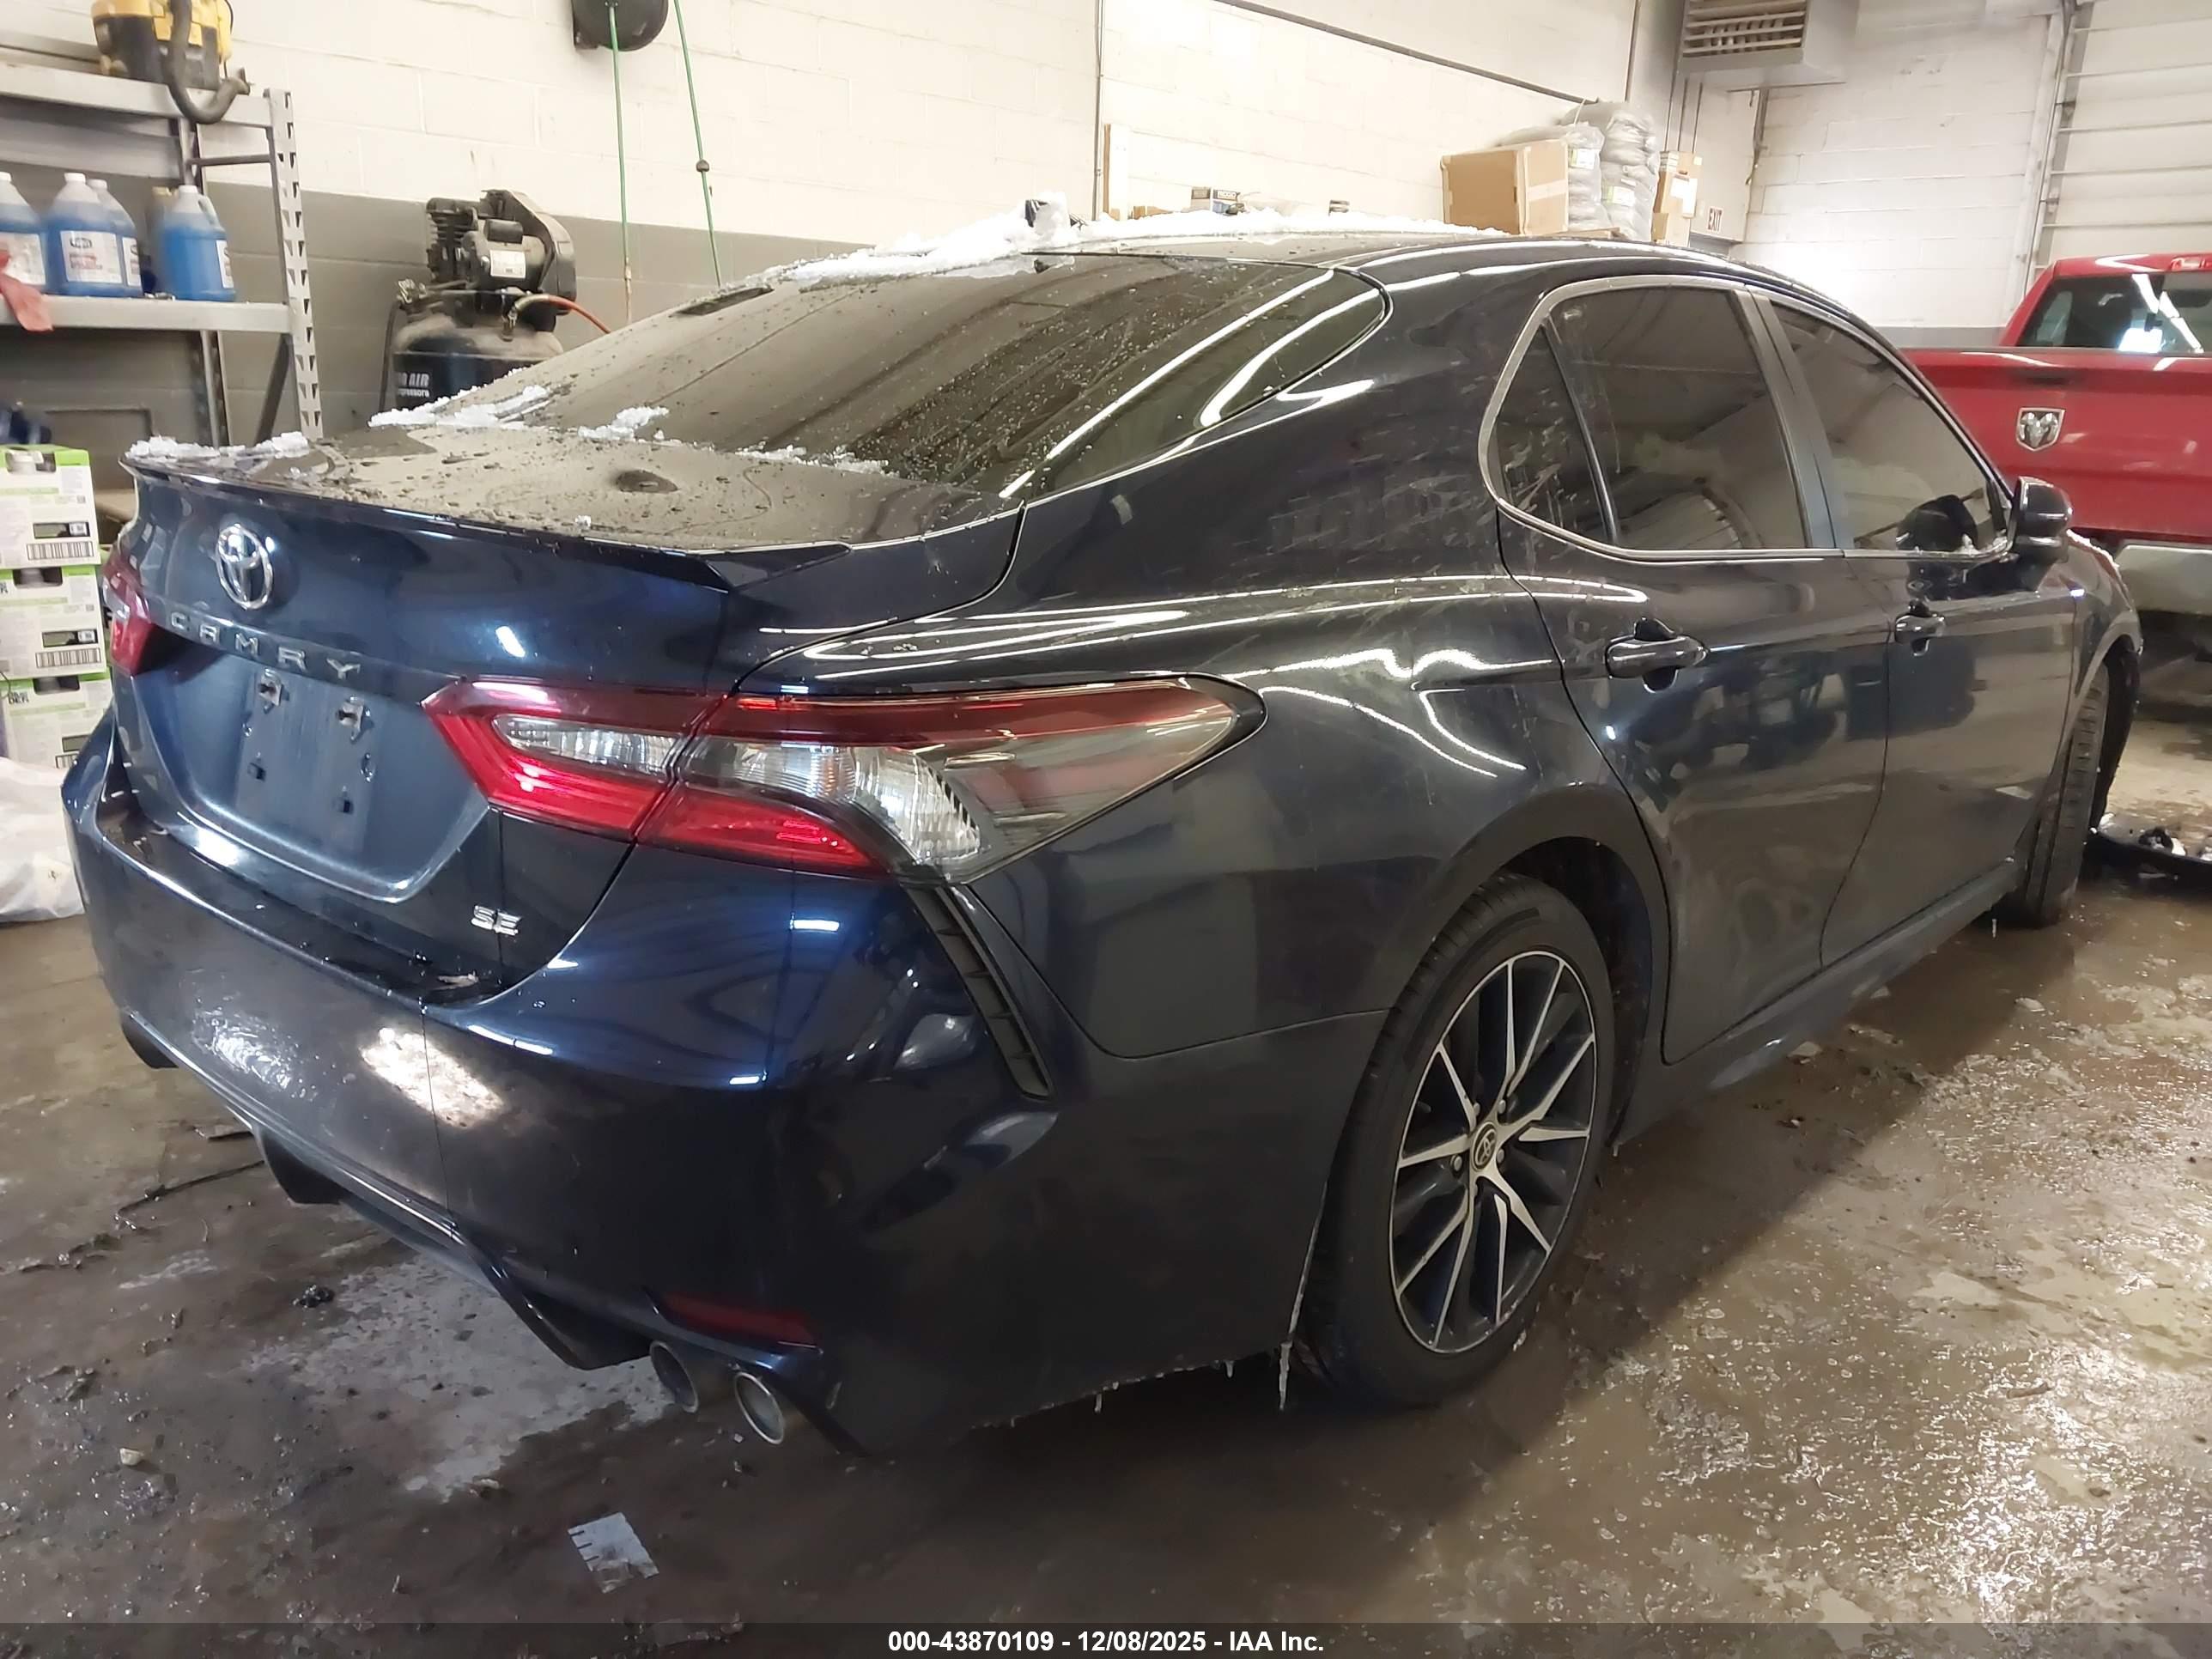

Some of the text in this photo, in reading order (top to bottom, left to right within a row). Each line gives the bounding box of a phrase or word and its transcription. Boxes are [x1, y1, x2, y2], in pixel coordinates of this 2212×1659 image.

[1708, 207, 1723, 232] EXIT
[409, 373, 429, 387] AIR
[171, 611, 362, 679] CAMRY
[471, 905, 522, 936] SE
